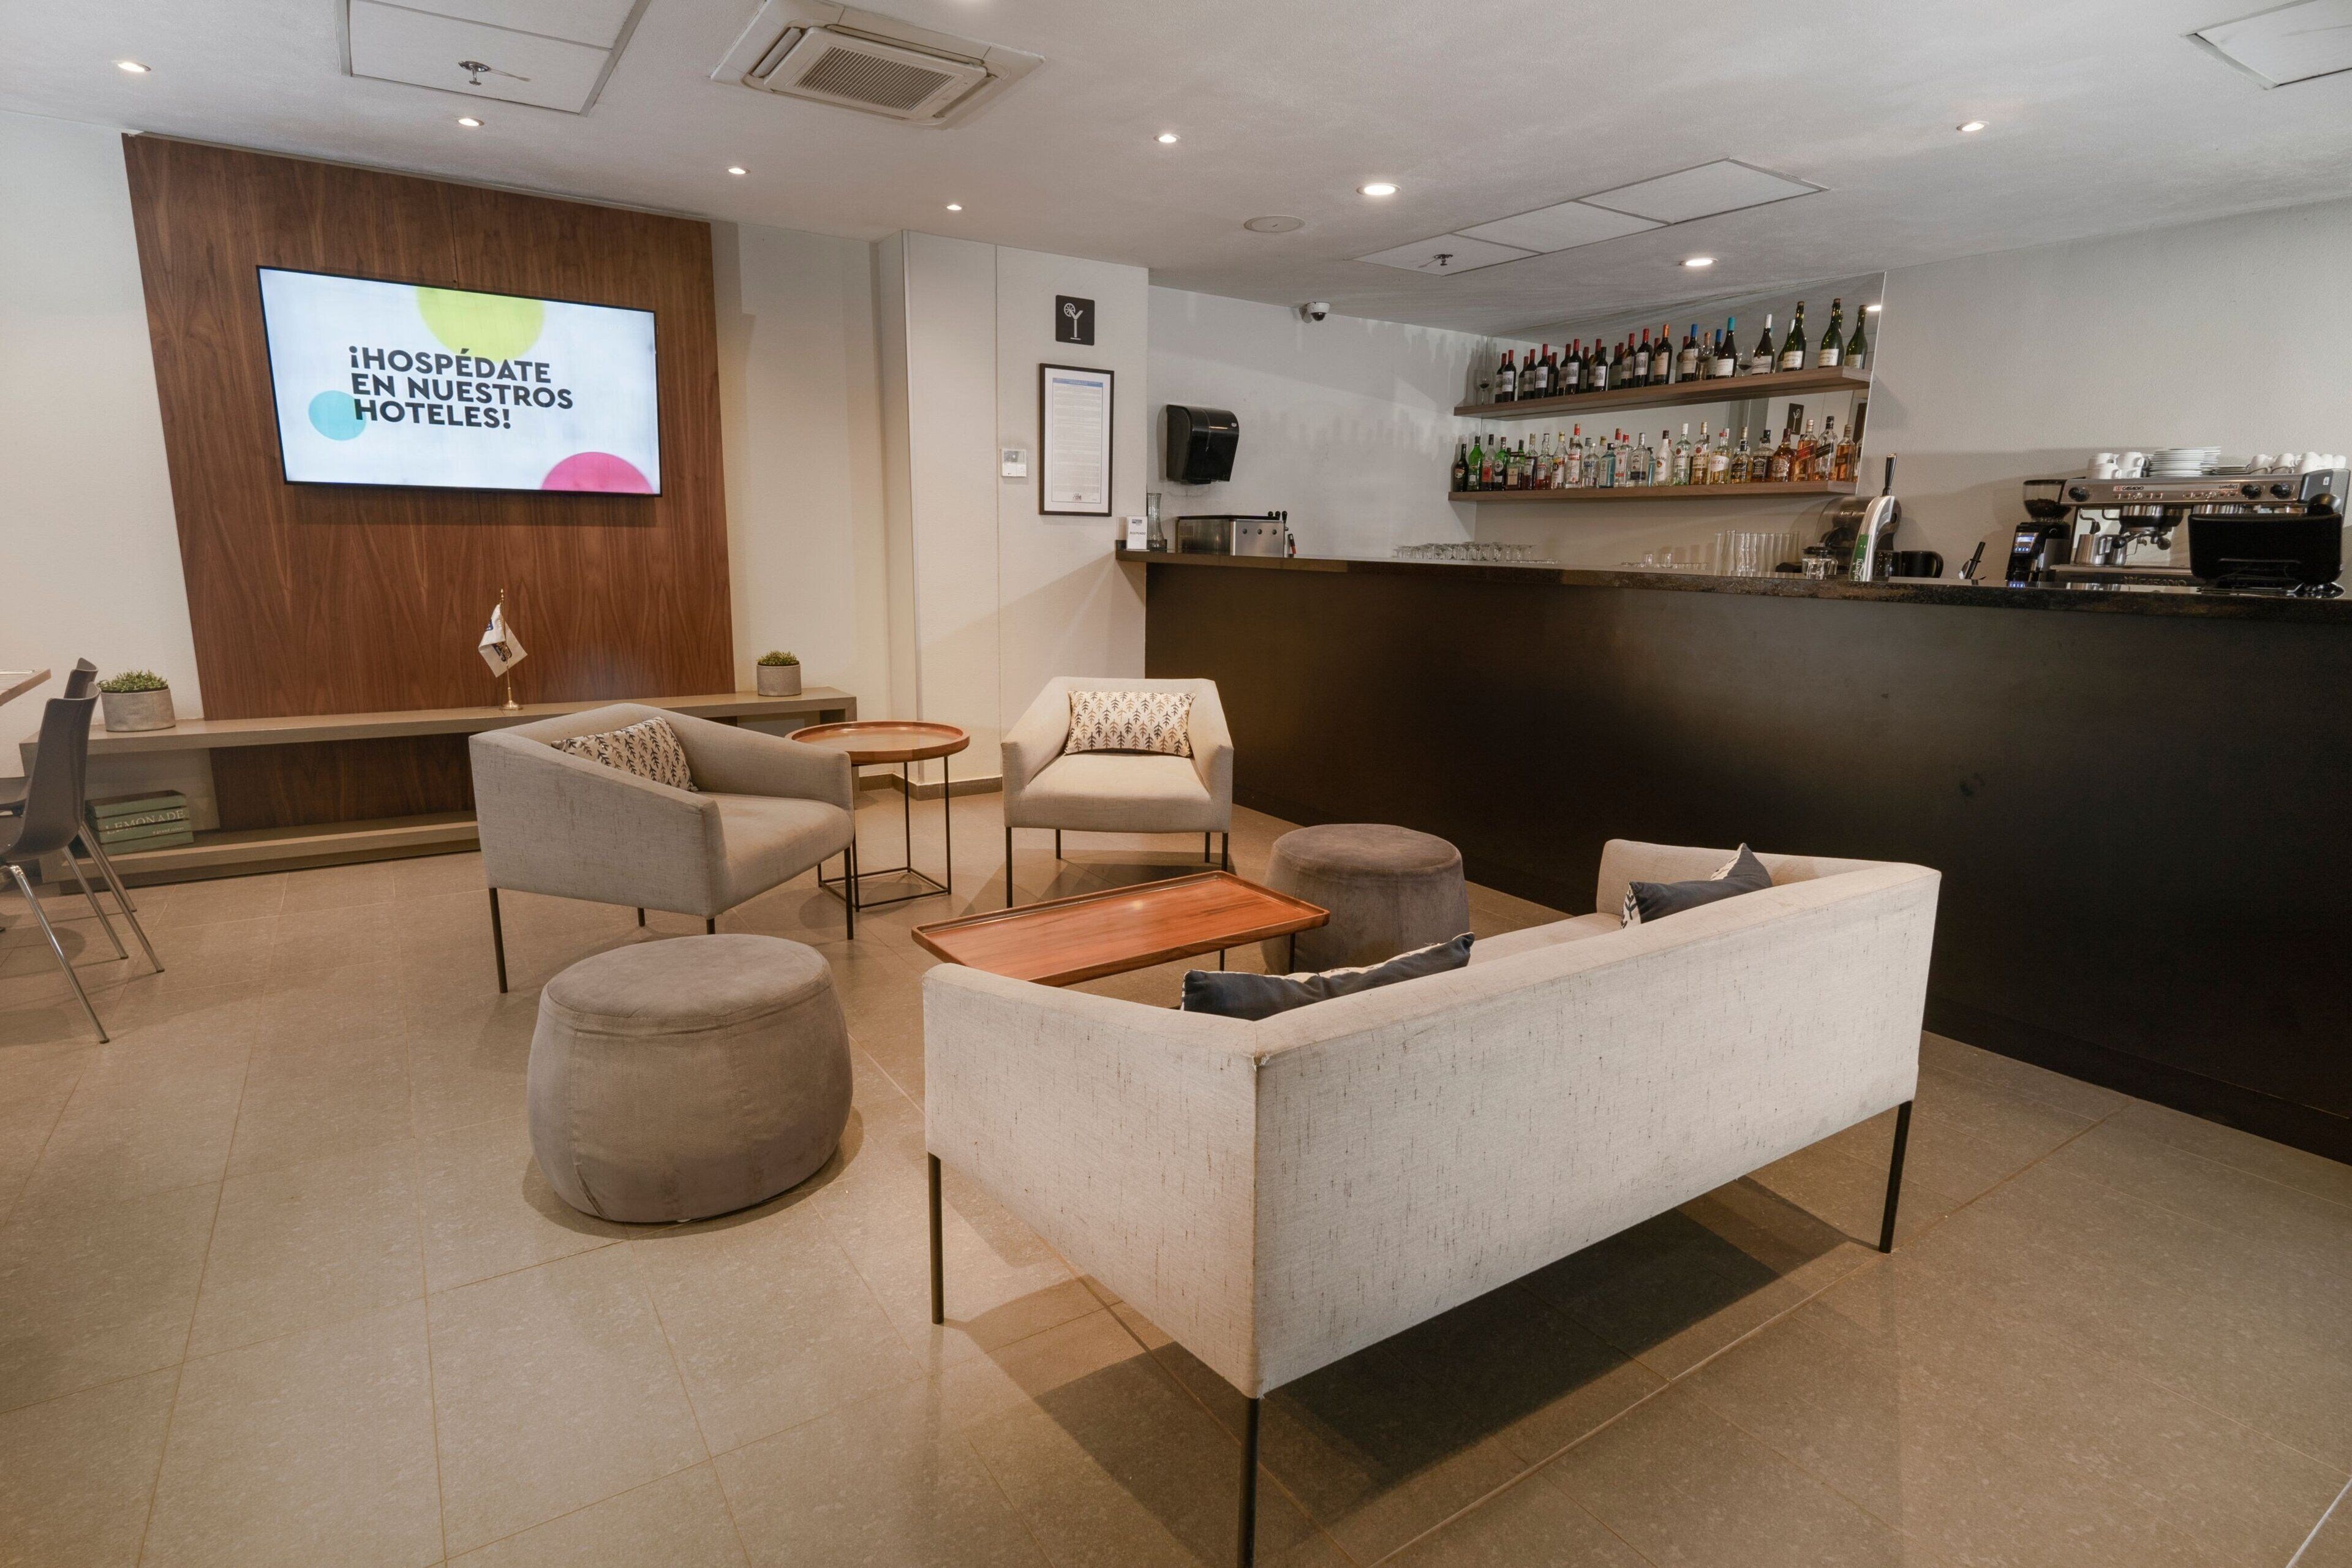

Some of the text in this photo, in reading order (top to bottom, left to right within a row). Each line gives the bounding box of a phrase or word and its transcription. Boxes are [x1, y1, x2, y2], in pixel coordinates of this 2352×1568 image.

[349, 345, 551, 383] ¡HOSPÉDATE
[351, 372, 573, 410] EN NUESTROS
[354, 398, 511, 429] HOTELES!
[105, 809, 186, 835] LEMONADE
